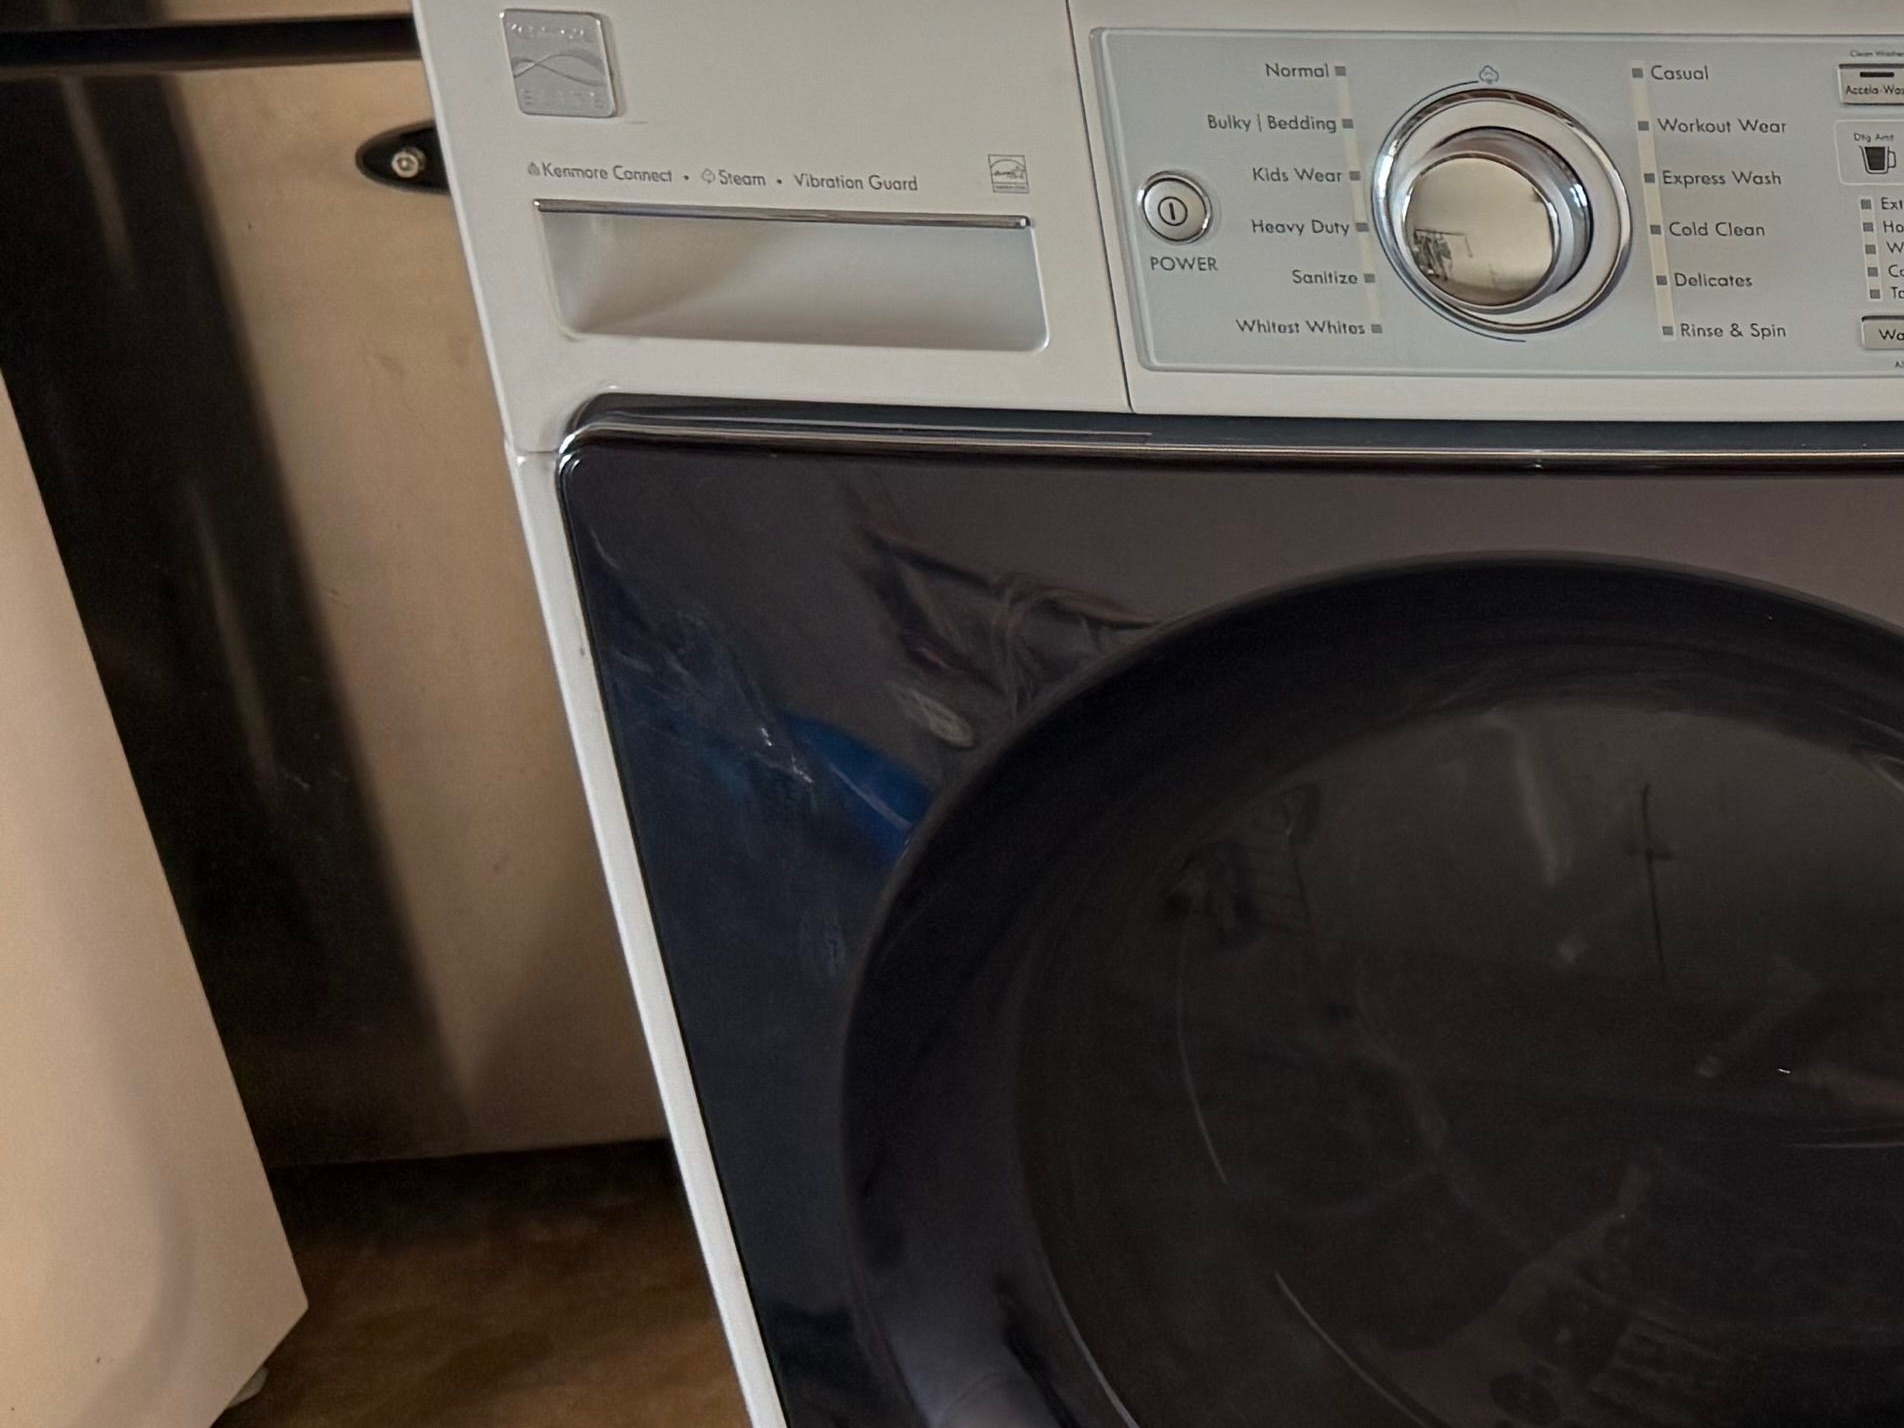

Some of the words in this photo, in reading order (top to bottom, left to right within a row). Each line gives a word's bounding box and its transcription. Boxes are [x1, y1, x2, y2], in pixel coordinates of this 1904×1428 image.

[1265, 63, 1329, 78] Normal
[1650, 65, 1709, 81] Casual
[1207, 115, 1251, 132] Bulky
[1267, 115, 1336, 133] Bedding
[1657, 118, 1731, 133] Workout
[1738, 119, 1786, 133] Wear
[542, 162, 608, 182] Kenmore
[613, 164, 673, 183] Connect
[718, 170, 766, 188] Steam
[794, 173, 863, 191] Vibration
[869, 174, 918, 192] Guard
[1252, 168, 1289, 182] Kids
[1294, 168, 1342, 182] Wear
[1663, 171, 1726, 188] Express
[1732, 171, 1781, 185] Wash
[1251, 220, 1304, 236] Heavy
[1312, 220, 1350, 236] Duty
[1669, 222, 1708, 236] Cold
[1715, 223, 1765, 237] Clean
[1150, 257, 1218, 272] POWER
[1292, 270, 1358, 284] Sanitize
[1674, 273, 1753, 287] Delicates
[1235, 319, 1300, 333] Whitest
[1306, 320, 1365, 335] Whites
[1680, 324, 1723, 337] Rinse
[1730, 324, 1743, 337] &
[1751, 323, 1786, 340] Spin
